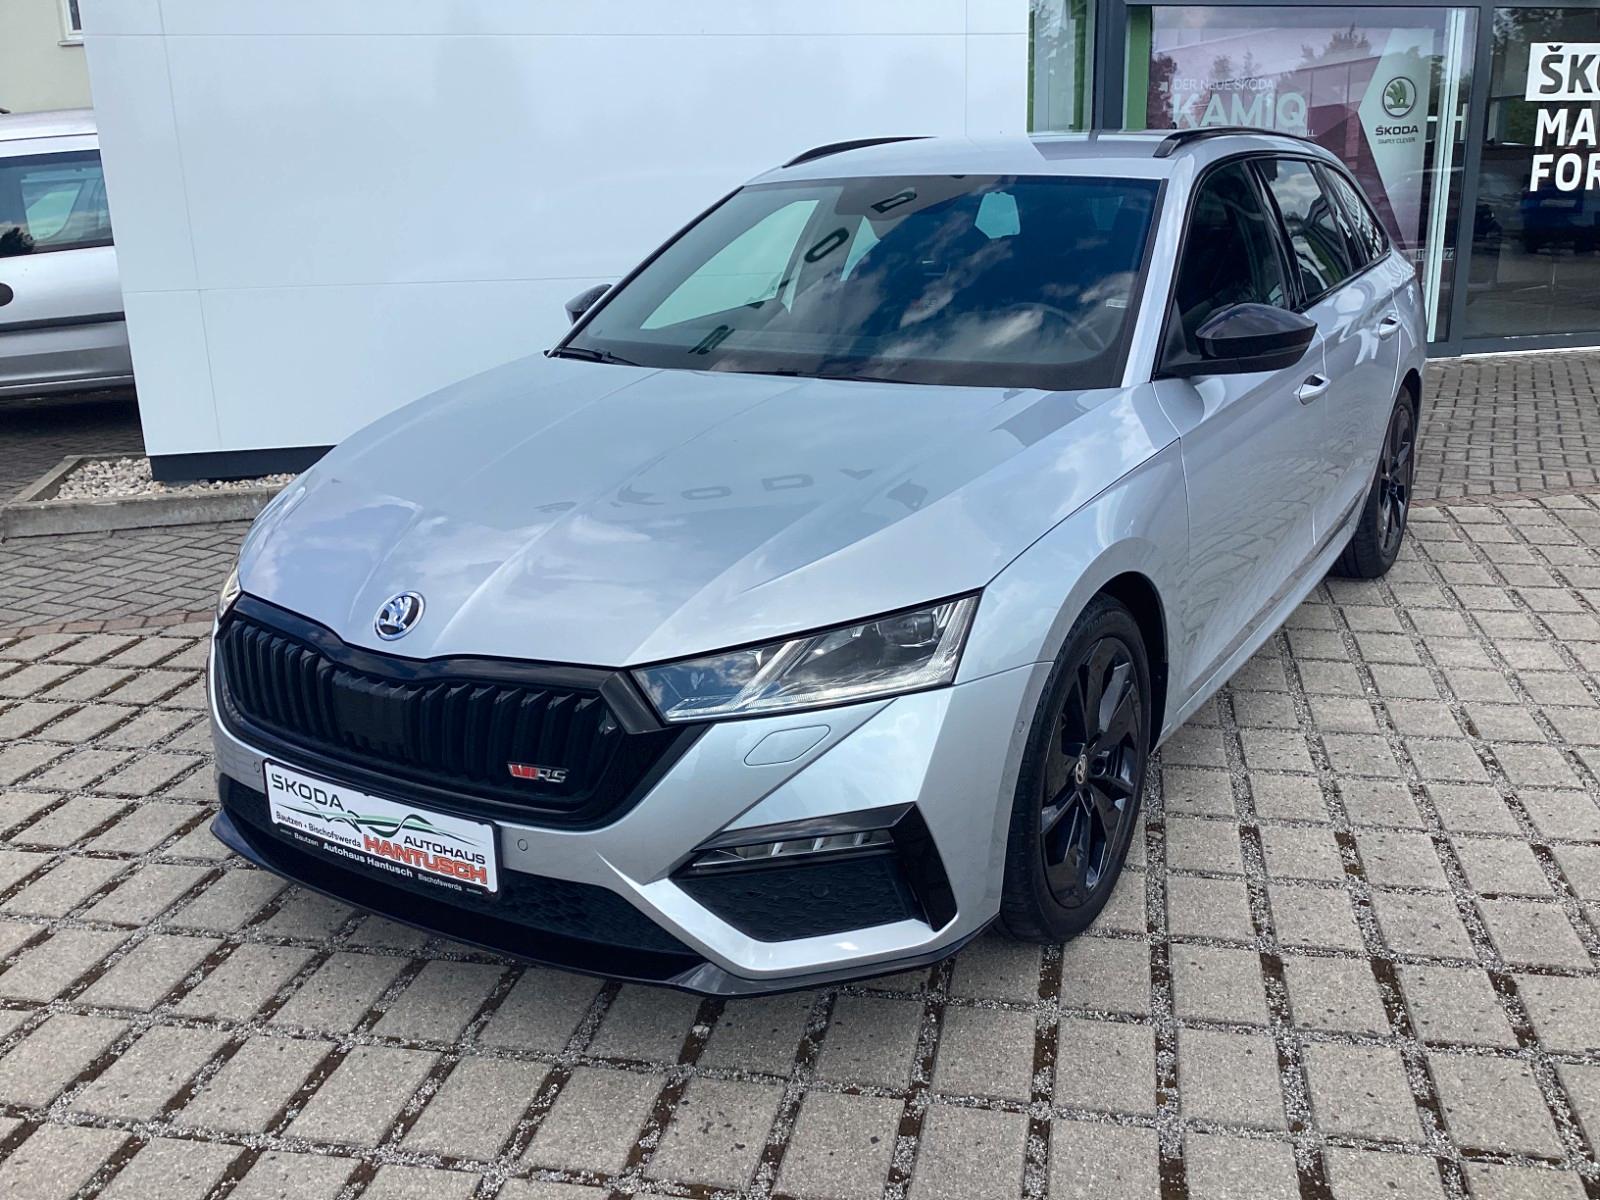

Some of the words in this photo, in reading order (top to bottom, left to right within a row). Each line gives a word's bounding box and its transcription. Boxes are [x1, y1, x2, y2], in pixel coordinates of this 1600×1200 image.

[1173, 79, 1198, 90] DER
[1539, 45, 1600, 94] ŠK
[1172, 91, 1307, 128] KAMIQ
[275, 810, 303, 828] Bautzen
[308, 822, 362, 848] Bischofswerda
[293, 832, 319, 847] Bautzen
[322, 842, 366, 863] Autohaus
[367, 856, 413, 878] Hantusch
[417, 873, 463, 892] Bischofswerda
[363, 833, 488, 885] HANTUSCH
[403, 835, 486, 865] AUTOHAUS
